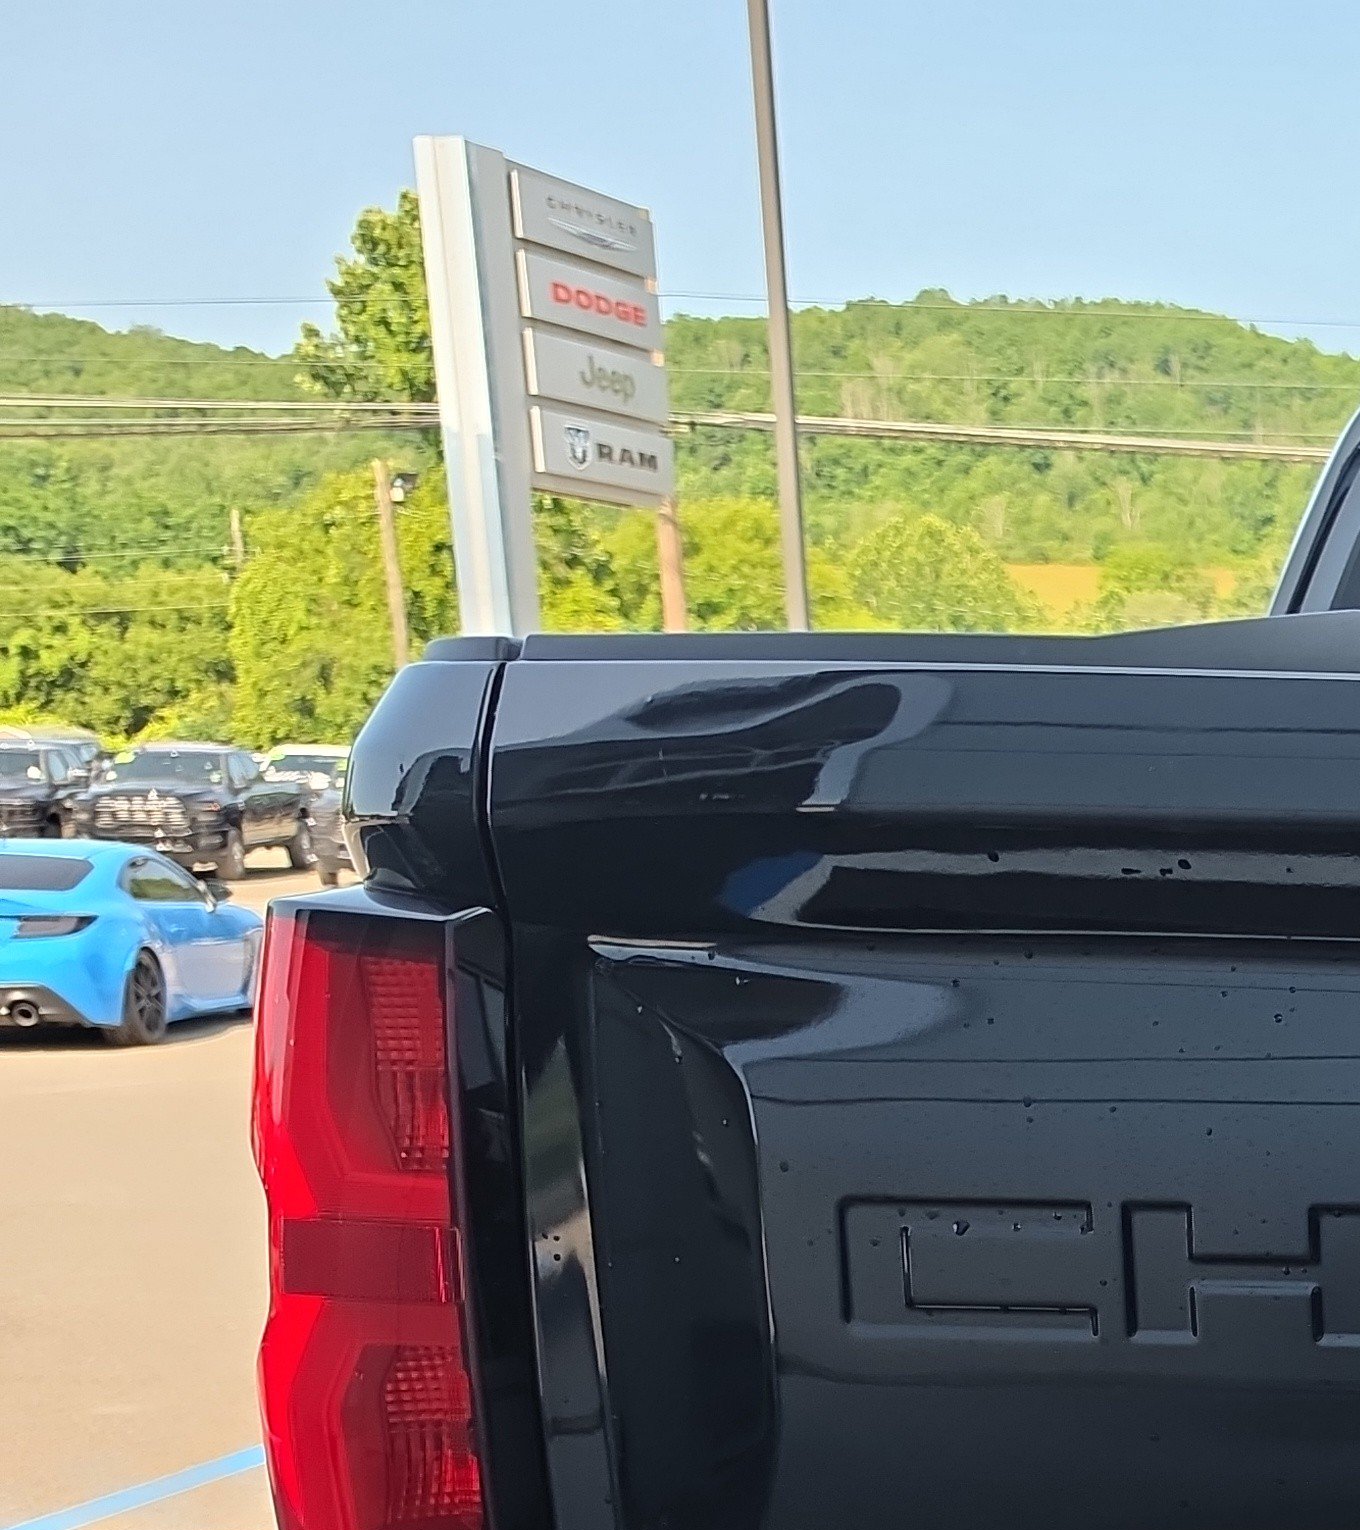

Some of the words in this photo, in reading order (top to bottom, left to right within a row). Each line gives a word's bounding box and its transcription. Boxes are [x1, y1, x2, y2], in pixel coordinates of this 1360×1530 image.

[551, 281, 647, 327] DODGE
[580, 355, 635, 404] Jeep
[597, 442, 658, 472] RAM
